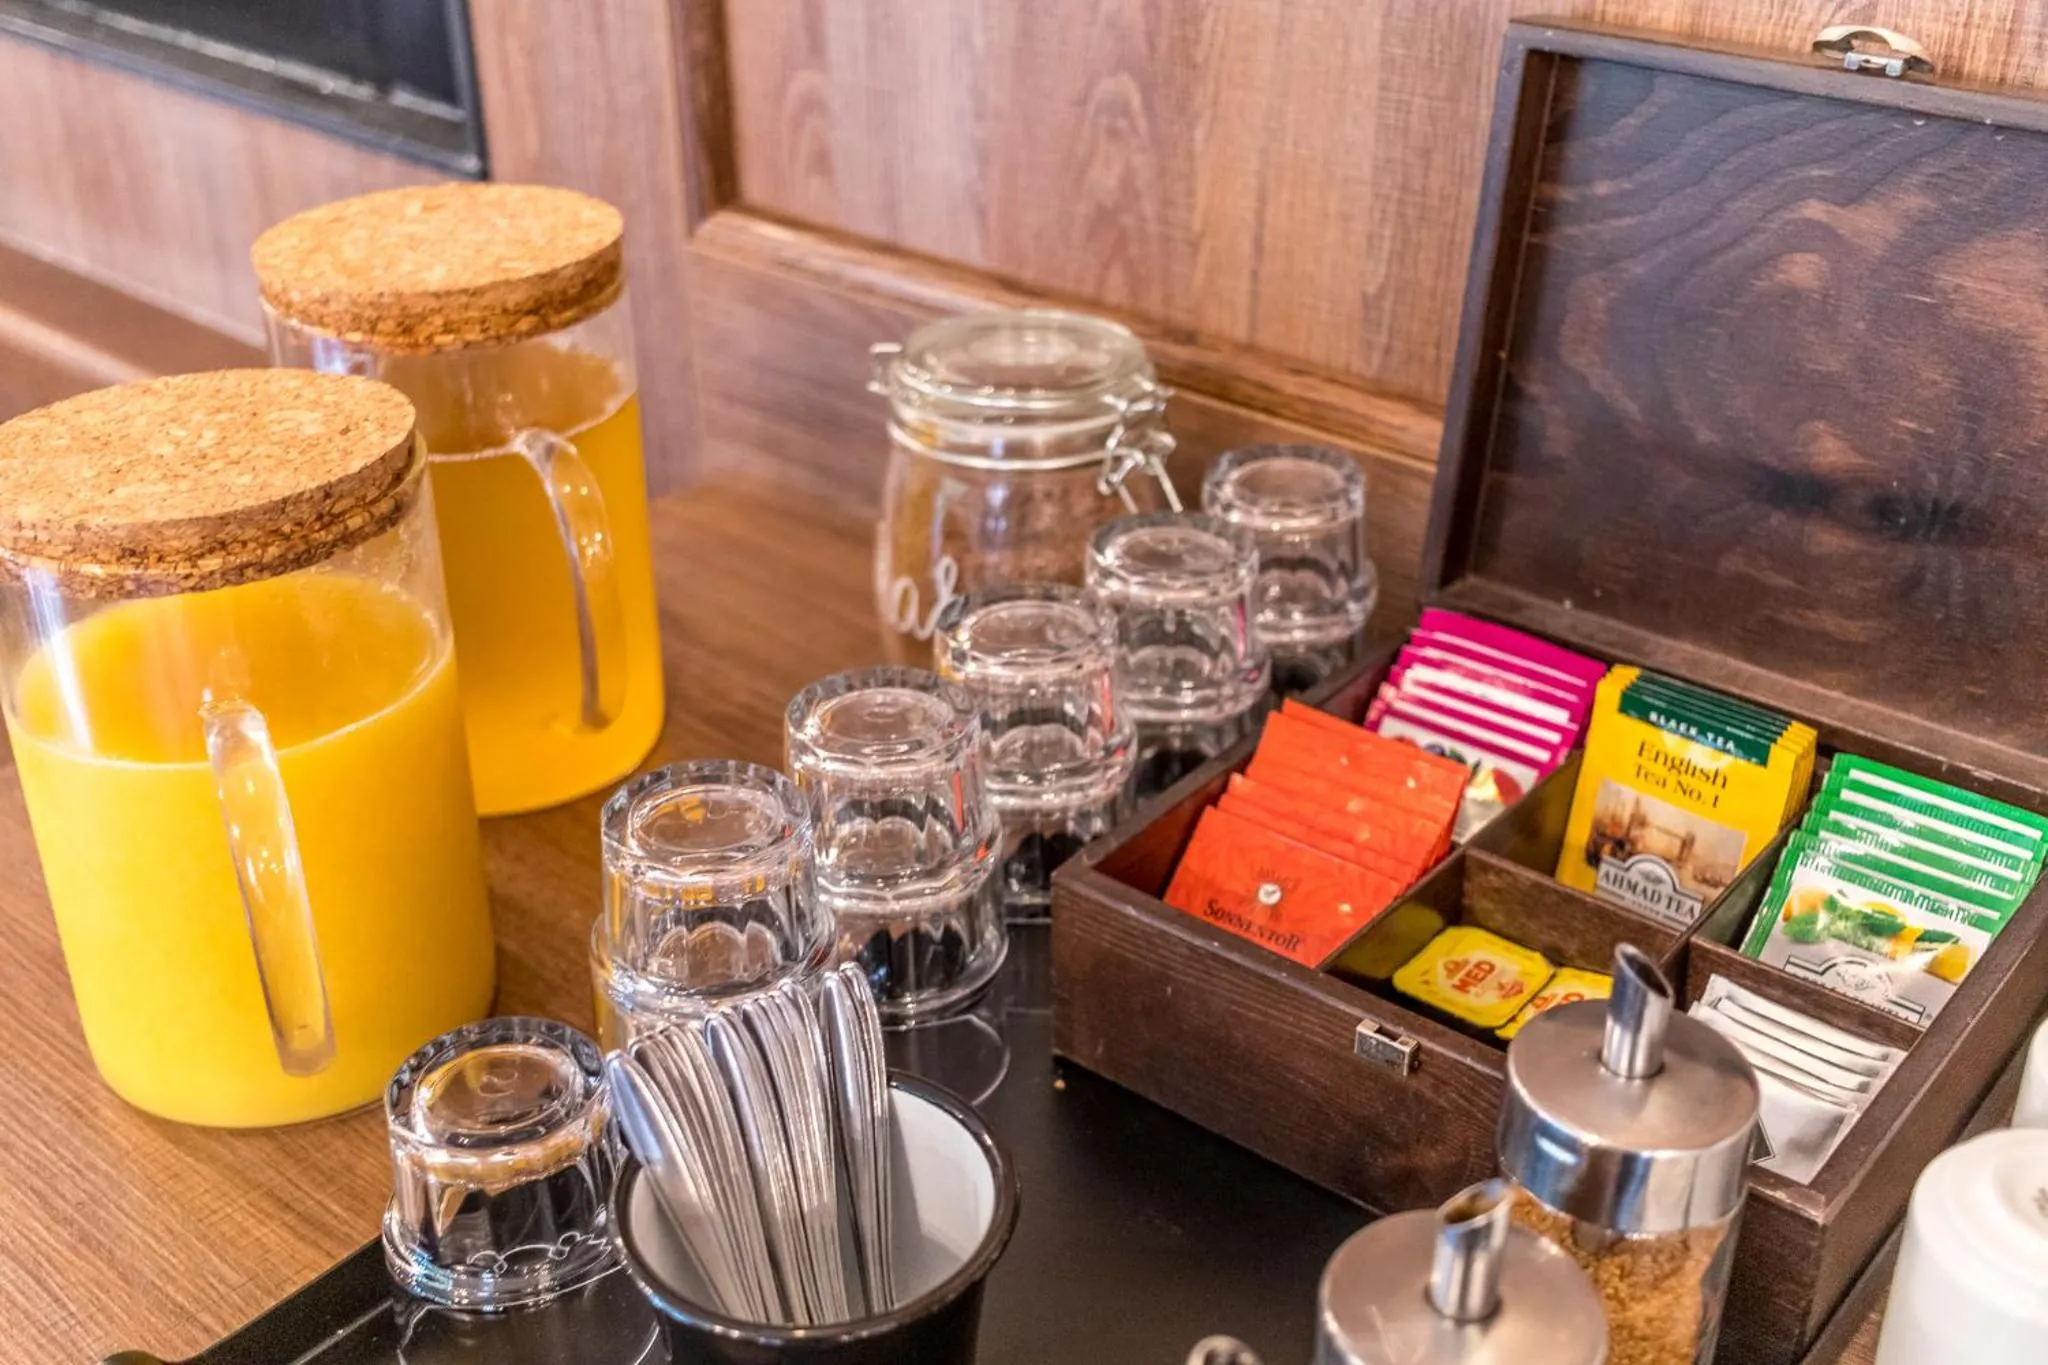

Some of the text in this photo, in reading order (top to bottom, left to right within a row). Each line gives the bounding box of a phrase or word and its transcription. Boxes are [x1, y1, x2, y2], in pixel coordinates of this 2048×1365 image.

[1649, 710, 1736, 750] BLACK TEA
[1636, 764, 1667, 788] Tea
[1638, 740, 1728, 788] English
[1601, 869, 1662, 903] AHMAD
[1666, 895, 1697, 921] TEA
[1451, 959, 1496, 993] MED
